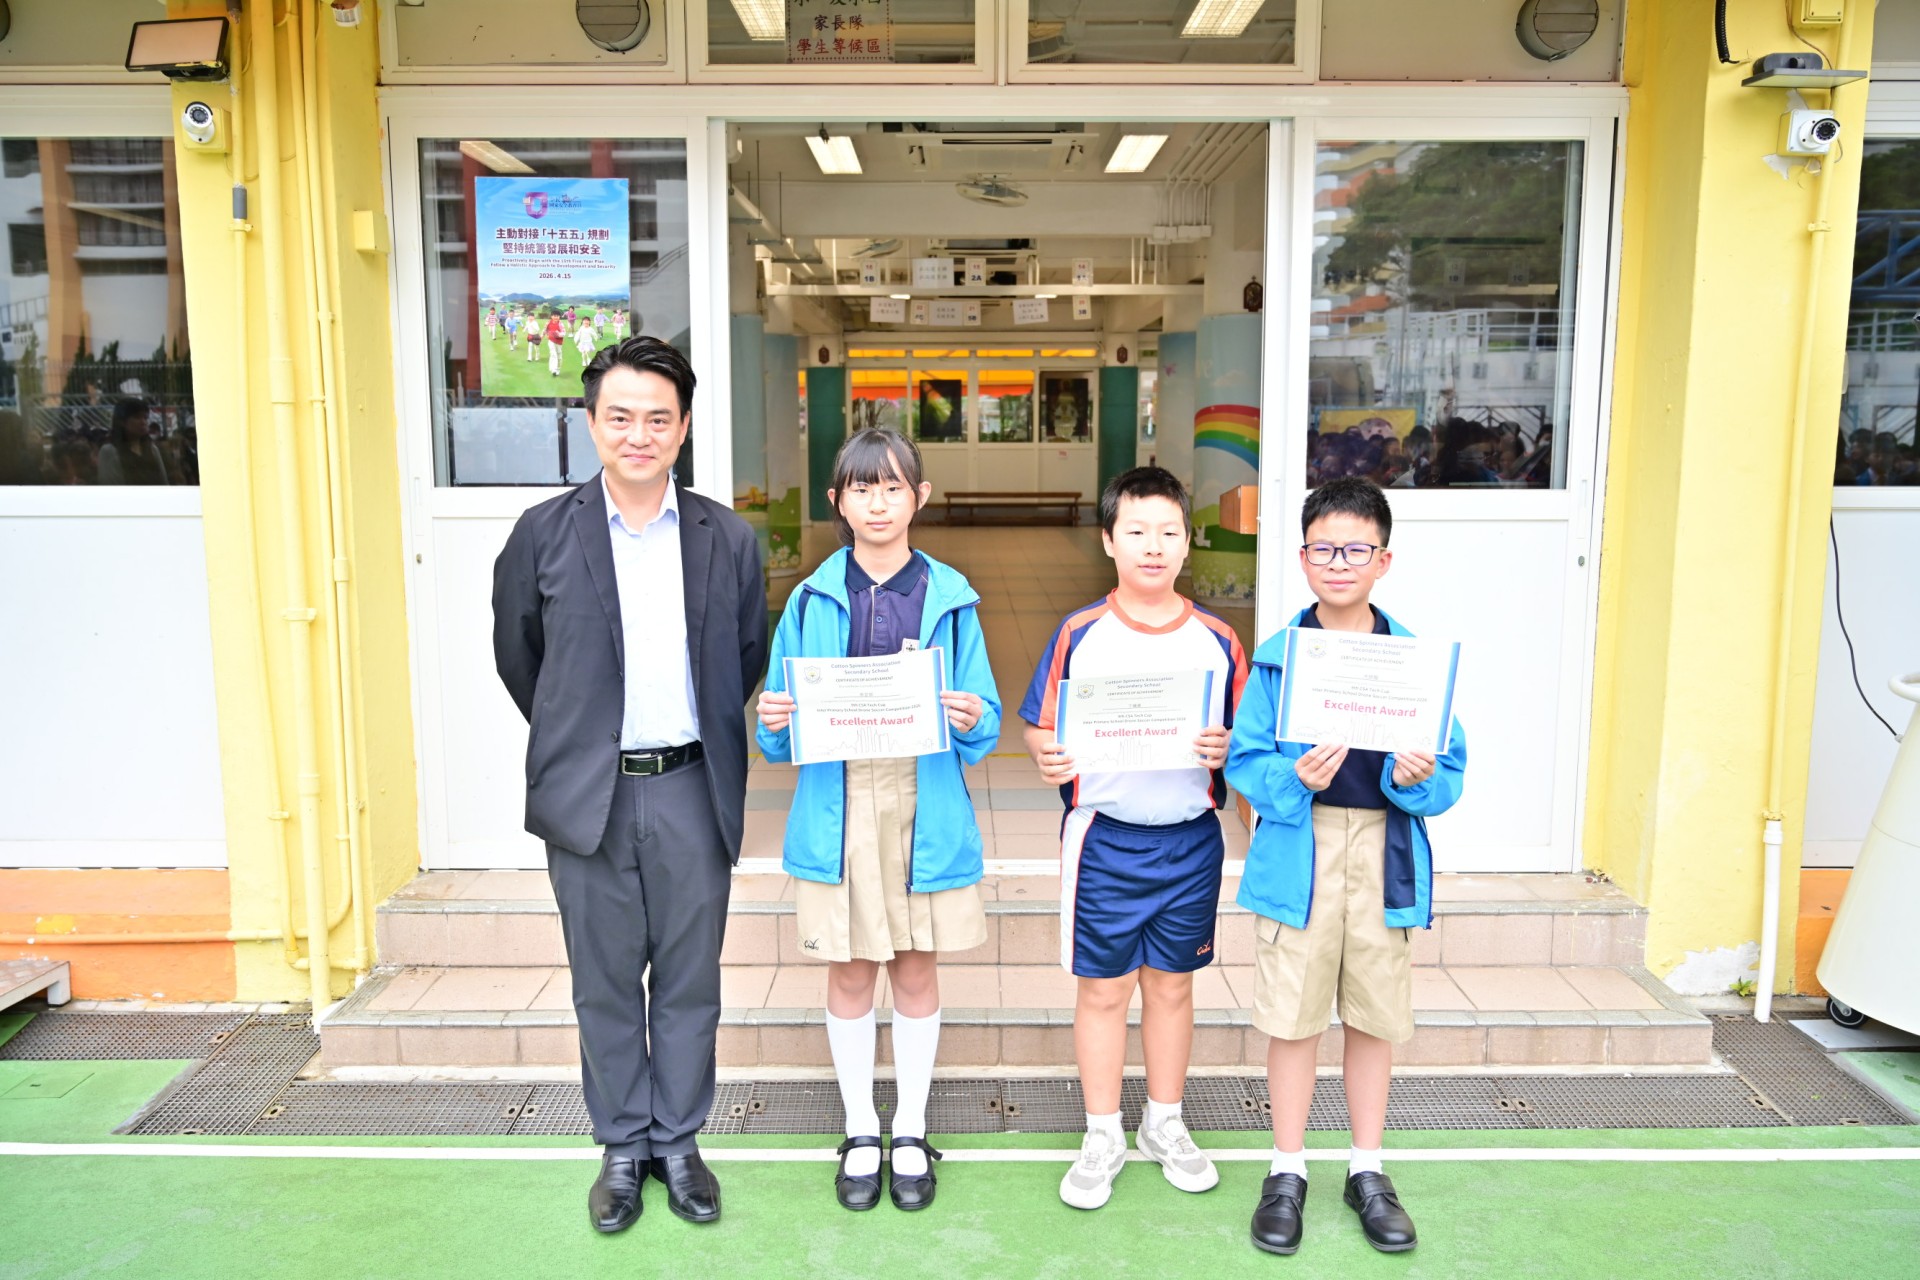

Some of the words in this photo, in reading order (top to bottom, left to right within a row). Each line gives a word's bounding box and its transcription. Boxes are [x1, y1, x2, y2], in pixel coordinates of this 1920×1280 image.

[814, 14, 864, 31] 家長隊
[796, 38, 880, 54] 學生等候區
[496, 228, 610, 240] 主動對接「十五五」規劃
[503, 242, 600, 255] 堅持統籌發展和安全
[1324, 700, 1377, 714] Excellent
[1380, 706, 1416, 717] Award
[830, 717, 878, 726] Excellent
[880, 714, 914, 725] Award
[1095, 728, 1142, 737] Excellent
[1144, 726, 1177, 736] Award
